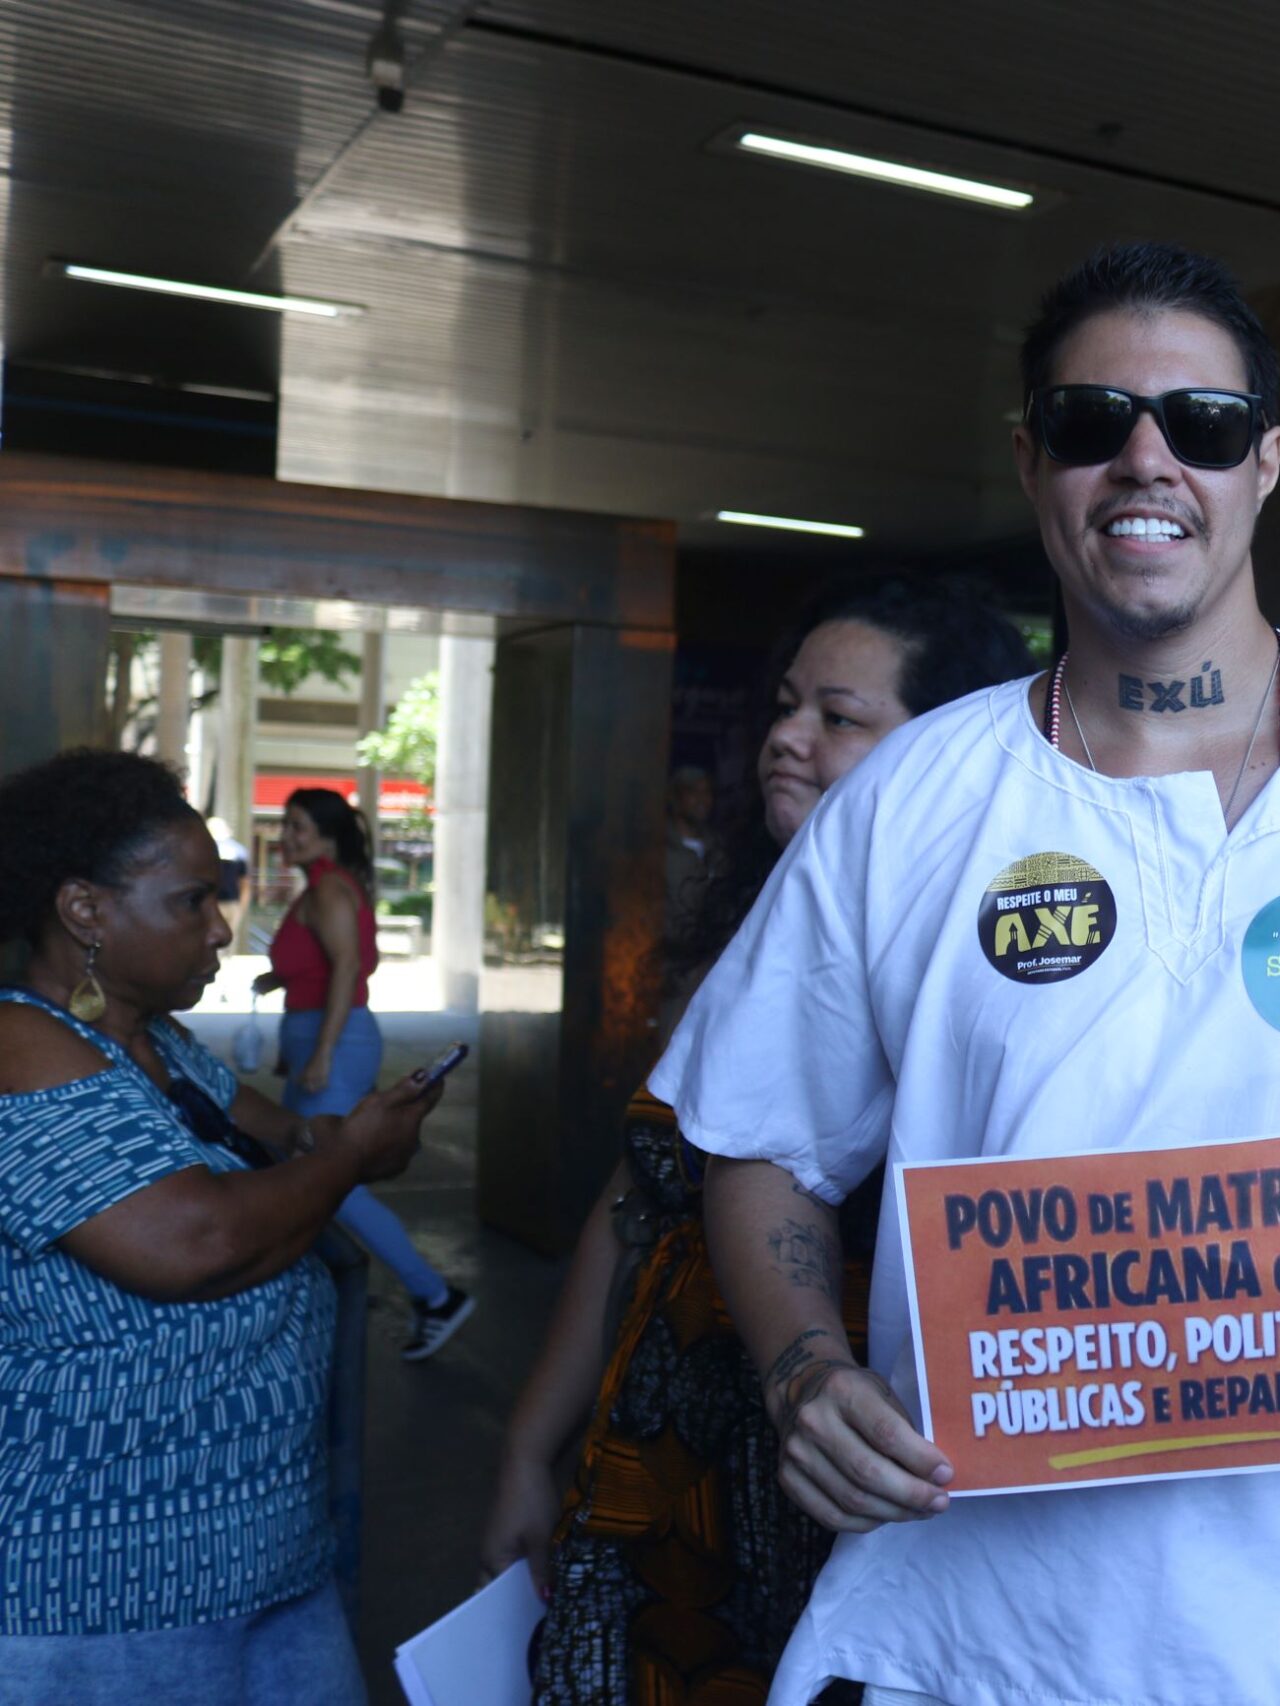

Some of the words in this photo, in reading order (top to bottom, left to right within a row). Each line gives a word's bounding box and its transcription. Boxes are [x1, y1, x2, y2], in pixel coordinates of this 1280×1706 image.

[1118, 660, 1225, 713] EXÚ
[997, 891, 1041, 910] RESPEITE
[1044, 890, 1051, 902] O
[1053, 888, 1078, 902] MEU
[1038, 955, 1082, 966] Josemar
[943, 1184, 1079, 1251] POVO
[1088, 1192, 1134, 1236] DE
[985, 1239, 1262, 1316] AFRICANA
[968, 1320, 1179, 1379] RESPEITO,
[970, 1379, 1146, 1438] PÚBLICAS
[1153, 1386, 1172, 1424] E
